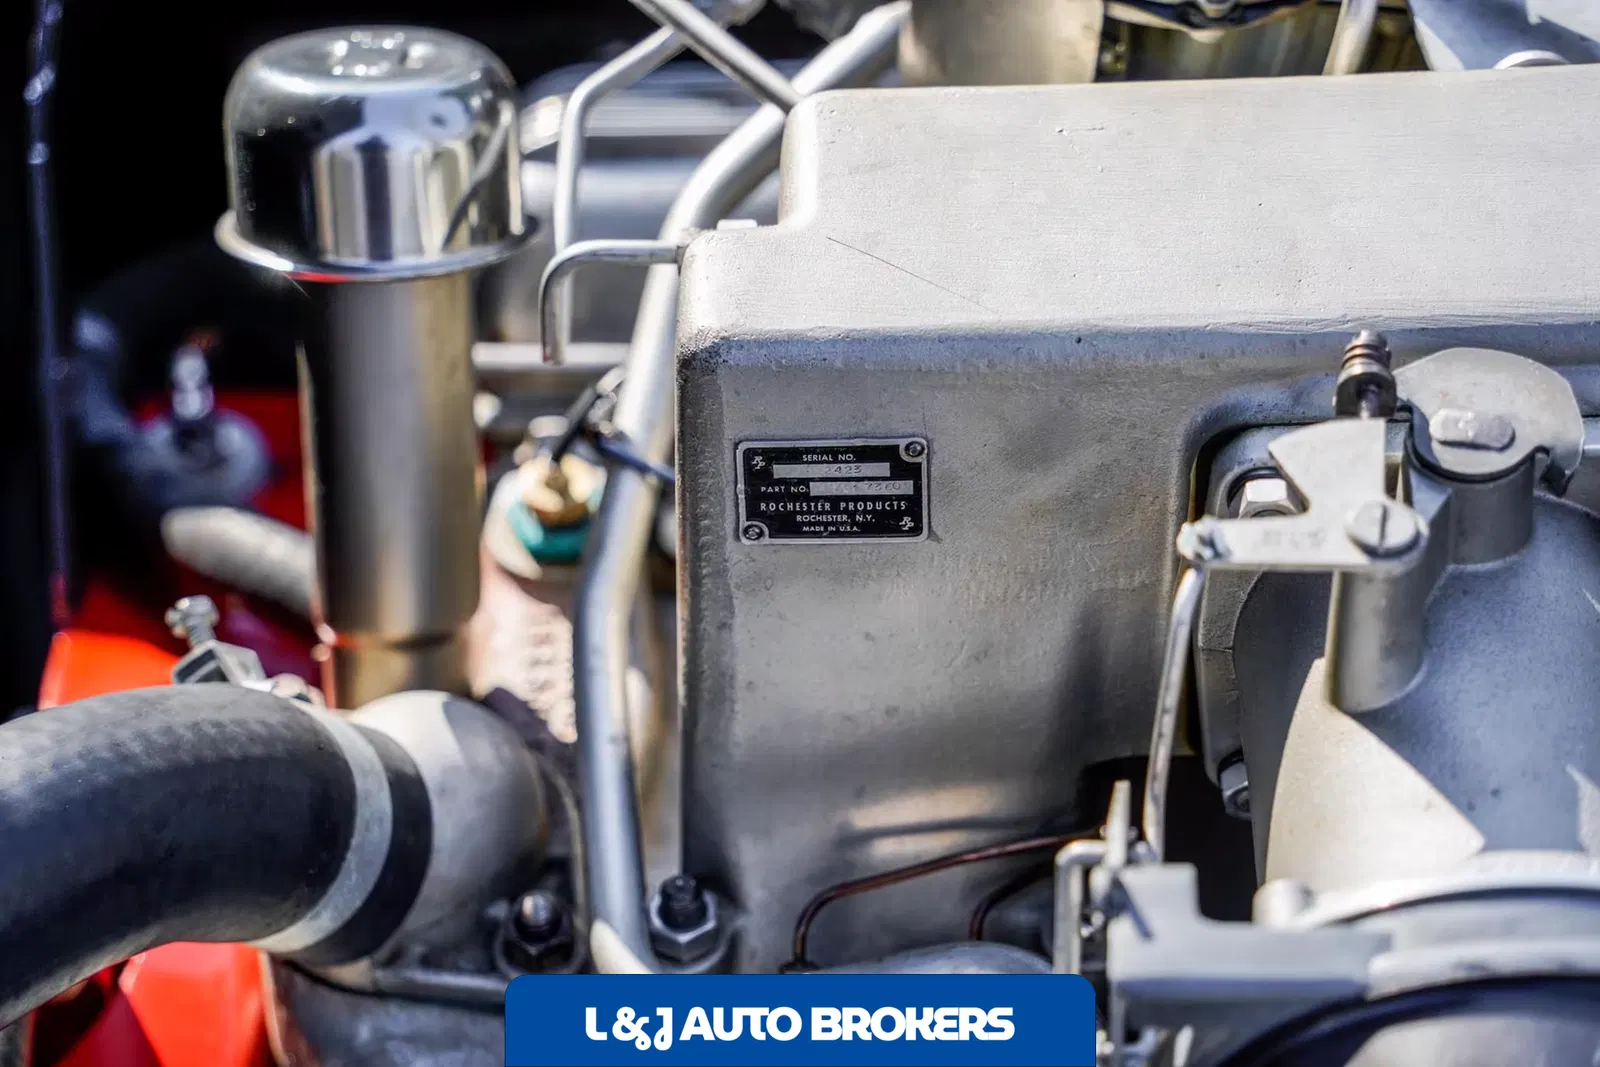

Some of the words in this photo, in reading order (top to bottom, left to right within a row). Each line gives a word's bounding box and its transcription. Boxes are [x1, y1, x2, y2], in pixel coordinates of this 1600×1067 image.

[838, 453, 856, 461] NO.
[790, 485, 810, 493] NO.
[760, 502, 831, 511] ROCHESTER
[840, 501, 906, 510] PRODUCTS
[796, 514, 851, 523] ROCHESTER,
[855, 514, 876, 522] N.Y.
